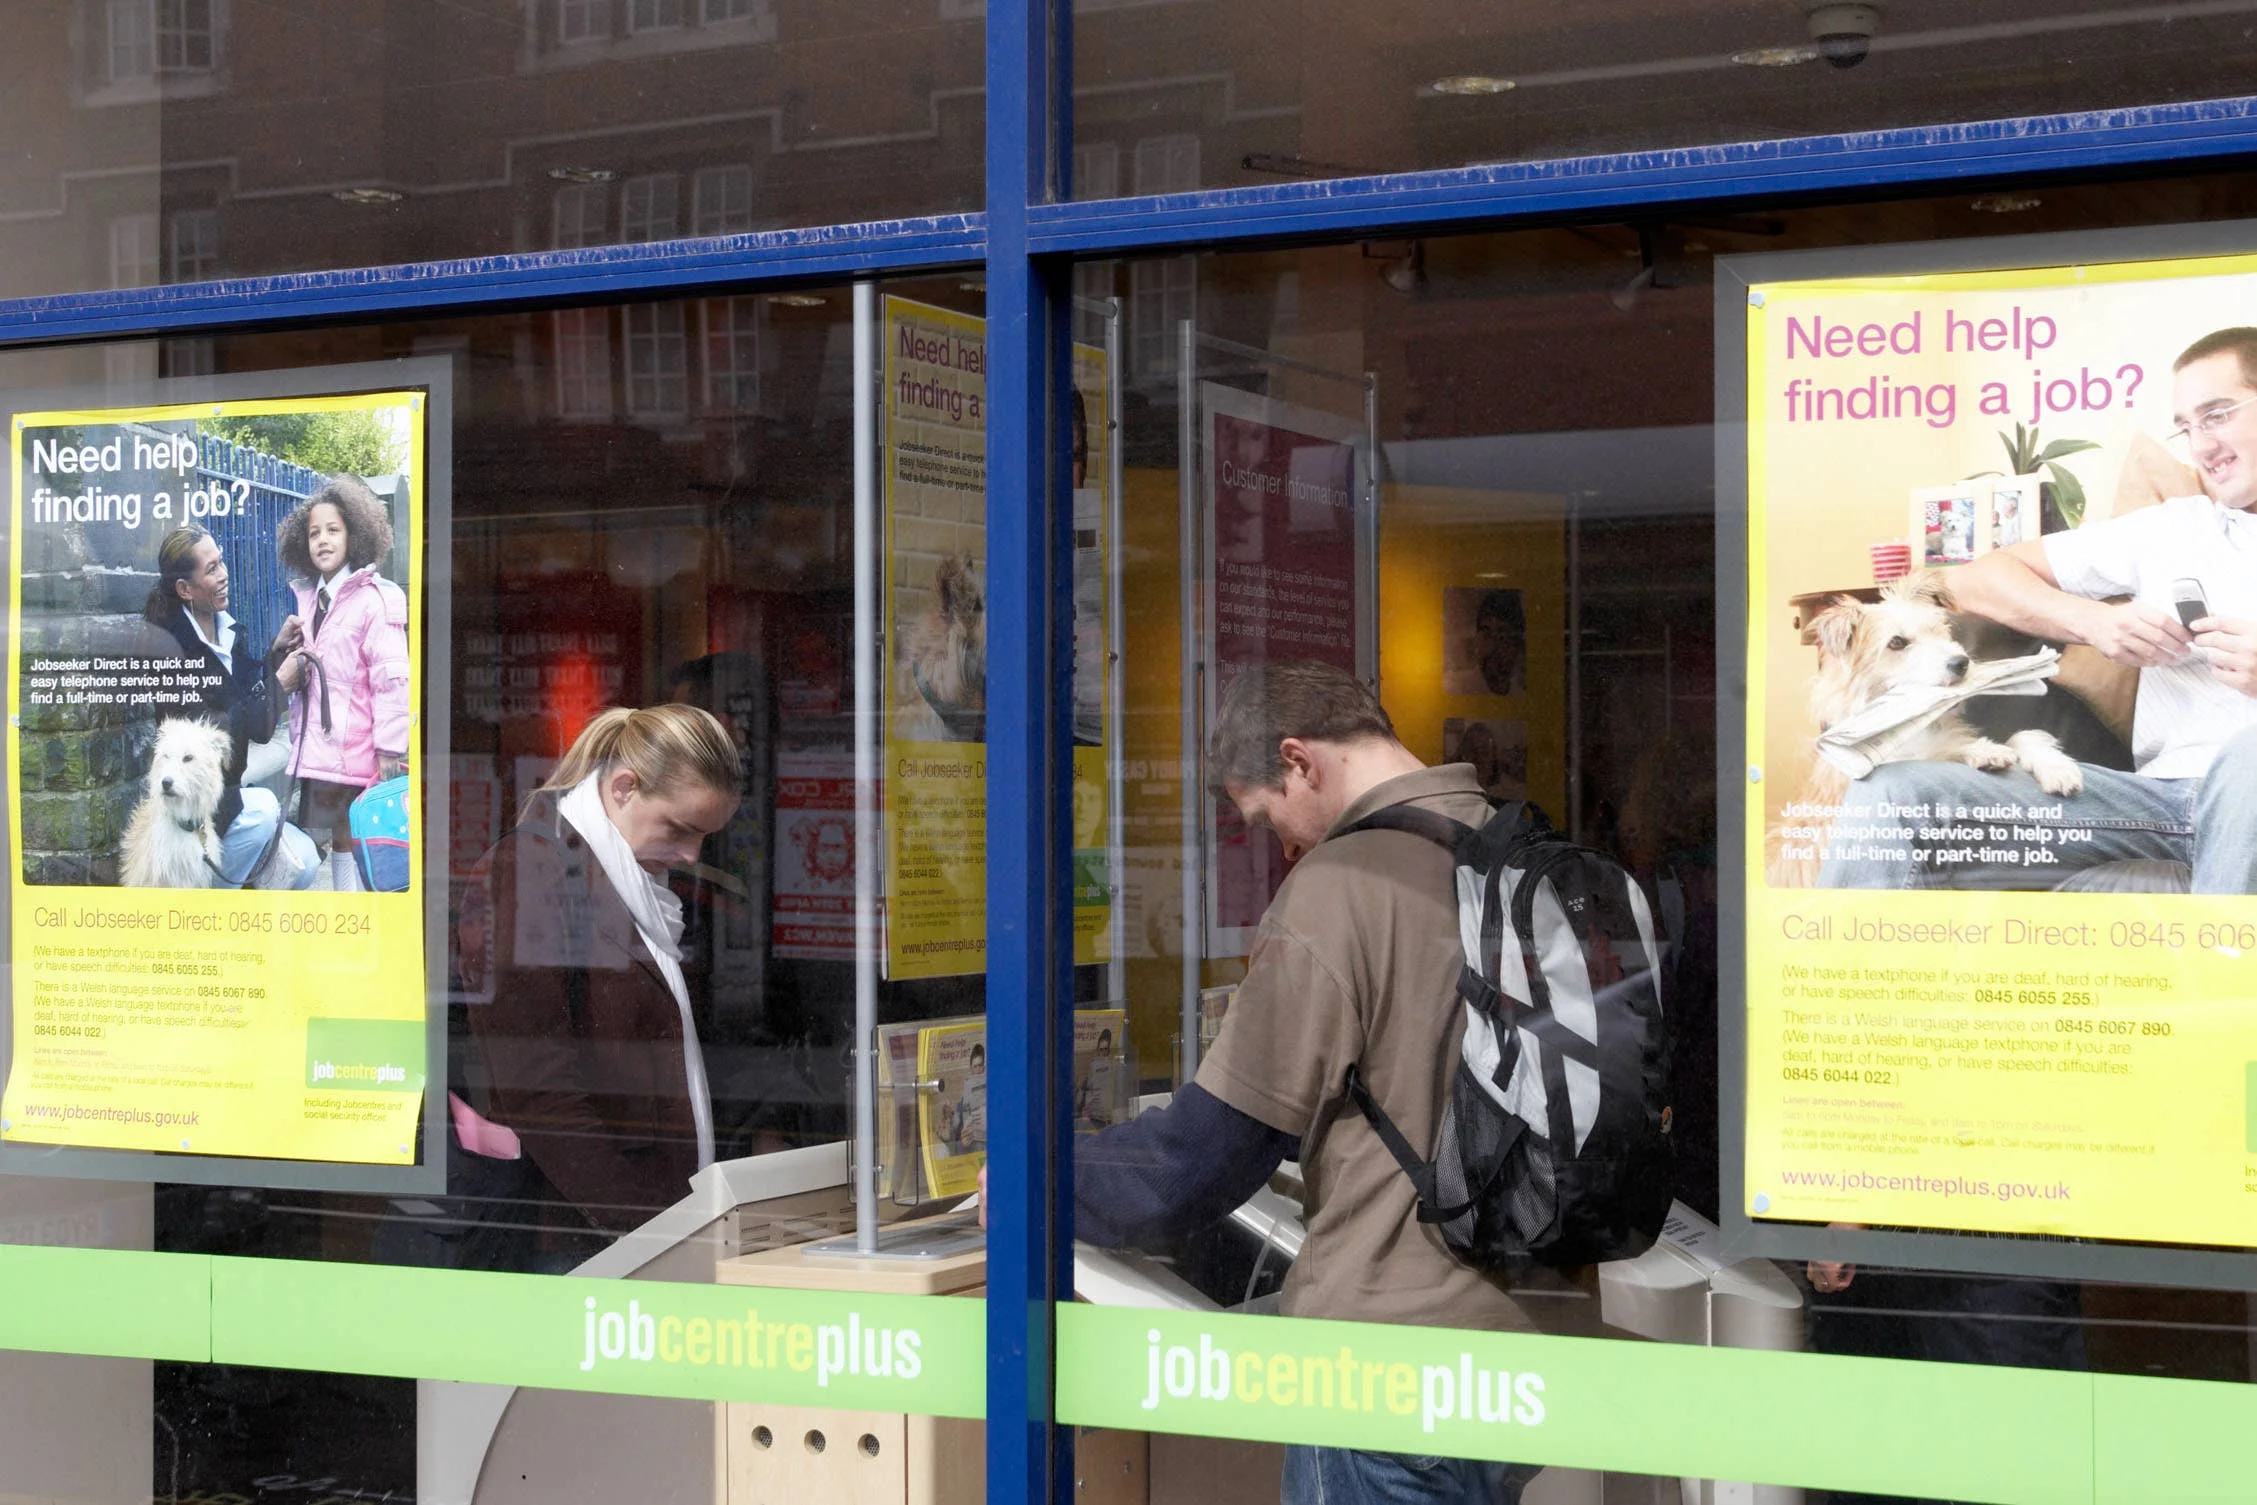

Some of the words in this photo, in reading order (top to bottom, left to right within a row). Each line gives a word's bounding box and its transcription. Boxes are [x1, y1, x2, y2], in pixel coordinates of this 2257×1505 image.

[1785, 311, 1921, 359] Need
[1945, 306, 2057, 361] help
[900, 326, 950, 368] Need
[957, 339, 986, 382] hel
[899, 372, 962, 422] finding
[969, 393, 980, 418] a
[1783, 375, 1957, 429] finding
[1979, 381, 2010, 416] a
[2027, 362, 2144, 425] job?
[32, 438, 121, 473] Need
[134, 432, 198, 477] help
[1222, 459, 1282, 495] Customer
[1284, 473, 1348, 507] Information
[32, 488, 141, 529] finding
[153, 496, 172, 519] a
[181, 479, 250, 527] job?
[30, 658, 91, 671] Jobseeker
[93, 657, 128, 670] Direct
[130, 657, 140, 670] is
[142, 660, 150, 670] a
[152, 657, 182, 672] quick
[184, 656, 205, 669] and
[30, 677, 58, 690] easy
[61, 675, 118, 690] telephone
[120, 675, 159, 687] service
[162, 675, 173, 686] to
[176, 674, 200, 689] help
[202, 675, 222, 689] you
[30, 691, 53, 704] find
[56, 695, 63, 704] a
[66, 691, 113, 704] full-time
[116, 694, 128, 704] or
[130, 691, 180, 706] part-time
[181, 691, 203, 706] job.
[898, 759, 917, 778] Call
[920, 759, 973, 779] Jobseeker
[1781, 803, 1872, 819] Jobseeker
[1877, 802, 1930, 819] Direct
[1935, 802, 1950, 819] is
[1955, 807, 1969, 819] a
[1972, 803, 2022, 822] quick
[2027, 803, 2062, 820] and
[1781, 828, 1821, 845] easy
[1826, 825, 1914, 844] telephone
[1919, 826, 1984, 842] service
[1989, 826, 2008, 842] to
[2013, 825, 2052, 845] help
[2058, 829, 2092, 846] you
[1781, 846, 1813, 862] find
[1820, 850, 1831, 862] a
[1836, 846, 1908, 862] full-time
[1912, 850, 1932, 862] or
[1936, 847, 2019, 866] part-time
[2023, 847, 2059, 867] job.
[34, 907, 67, 927] Call
[74, 907, 163, 930] Jobseeker
[168, 910, 222, 932] Direct:
[229, 911, 273, 933] 0845
[279, 912, 328, 934] 6060
[335, 913, 371, 935] 234
[1782, 914, 1832, 941] Call
[1843, 916, 1993, 945] Jobseeker
[2005, 918, 2097, 947] Direct:
[2110, 920, 2185, 948] 0845
[33, 945, 51, 958] (We
[54, 945, 75, 957] have
[78, 948, 84, 957] a
[87, 946, 130, 960] textphone
[133, 947, 138, 958] if
[139, 949, 156, 960] you
[157, 950, 172, 960] are
[197, 950, 217, 961] hard
[220, 950, 230, 961] of
[34, 961, 43, 970] or
[46, 960, 67, 971] have
[70, 961, 102, 974] speech
[152, 963, 174, 975] 0845
[176, 964, 198, 976] 6055
[1782, 964, 1808, 980] (We
[1813, 965, 1846, 981] have
[1851, 969, 1859, 980] a
[1865, 968, 1936, 984] textphone
[1941, 969, 1948, 982] if
[1954, 972, 1981, 986] you
[1986, 974, 2008, 985] are
[2014, 971, 2051, 987] deaf,
[2056, 972, 2089, 987] hard
[2094, 972, 2110, 987] of
[2113, 974, 2172, 992] hearing,
[198, 986, 220, 998] 0845
[222, 987, 244, 998] 6067
[1782, 986, 1796, 997] or
[1801, 984, 1834, 998] have
[1839, 985, 1890, 1001] speech
[1895, 986, 1968, 1002] difficulties:
[1974, 989, 2013, 1003] 0845
[2018, 990, 2056, 1005] 6055
[2062, 991, 2100, 1008] 255.)
[34, 1024, 57, 1036] 0845
[60, 1025, 82, 1037] 6044
[1782, 1010, 1822, 1025] There
[1826, 1011, 1837, 1025] is
[1842, 1015, 1850, 1026] a
[1855, 1013, 1898, 1028] Welsh
[1903, 1014, 1969, 1032] language
[1974, 1018, 2026, 1031] service
[2031, 1021, 2050, 1032] on
[2054, 1019, 2093, 1033] 0845
[2098, 1020, 2136, 1035] 6067
[2141, 1021, 2175, 1037] 890.
[1782, 1029, 1809, 1045] (We
[1814, 1030, 1846, 1045] have
[1851, 1034, 1860, 1046] a
[1864, 1032, 1908, 1048] Welsh
[1912, 1034, 1979, 1053] language
[1984, 1037, 2058, 1054] textphone
[2063, 1038, 2071, 1052] if
[2075, 1041, 2103, 1056] you
[2108, 1042, 2131, 1055] are
[312, 1060, 406, 1085] jobcentreplus
[1782, 1050, 1816, 1064] deaf,
[1821, 1051, 1853, 1065] hard
[1858, 1052, 1872, 1065] of
[1876, 1053, 1932, 1070] hearing,
[1938, 1057, 1952, 1068] or
[1957, 1056, 1991, 1070] have
[1997, 1058, 2052, 1073] speech
[2057, 1059, 2133, 1076] difficulties:
[1782, 1067, 1818, 1081] 0845
[1823, 1069, 1859, 1082] 6044
[1864, 1070, 1900, 1086] 022.)
[25, 1102, 199, 1127] www.jobcentreplus.gov.uk
[1781, 1168, 2071, 1202] www.jobcentreplus.gov.uk
[579, 1296, 922, 1386] jobcentreplus
[1141, 1328, 1546, 1432] jobcentreplus
